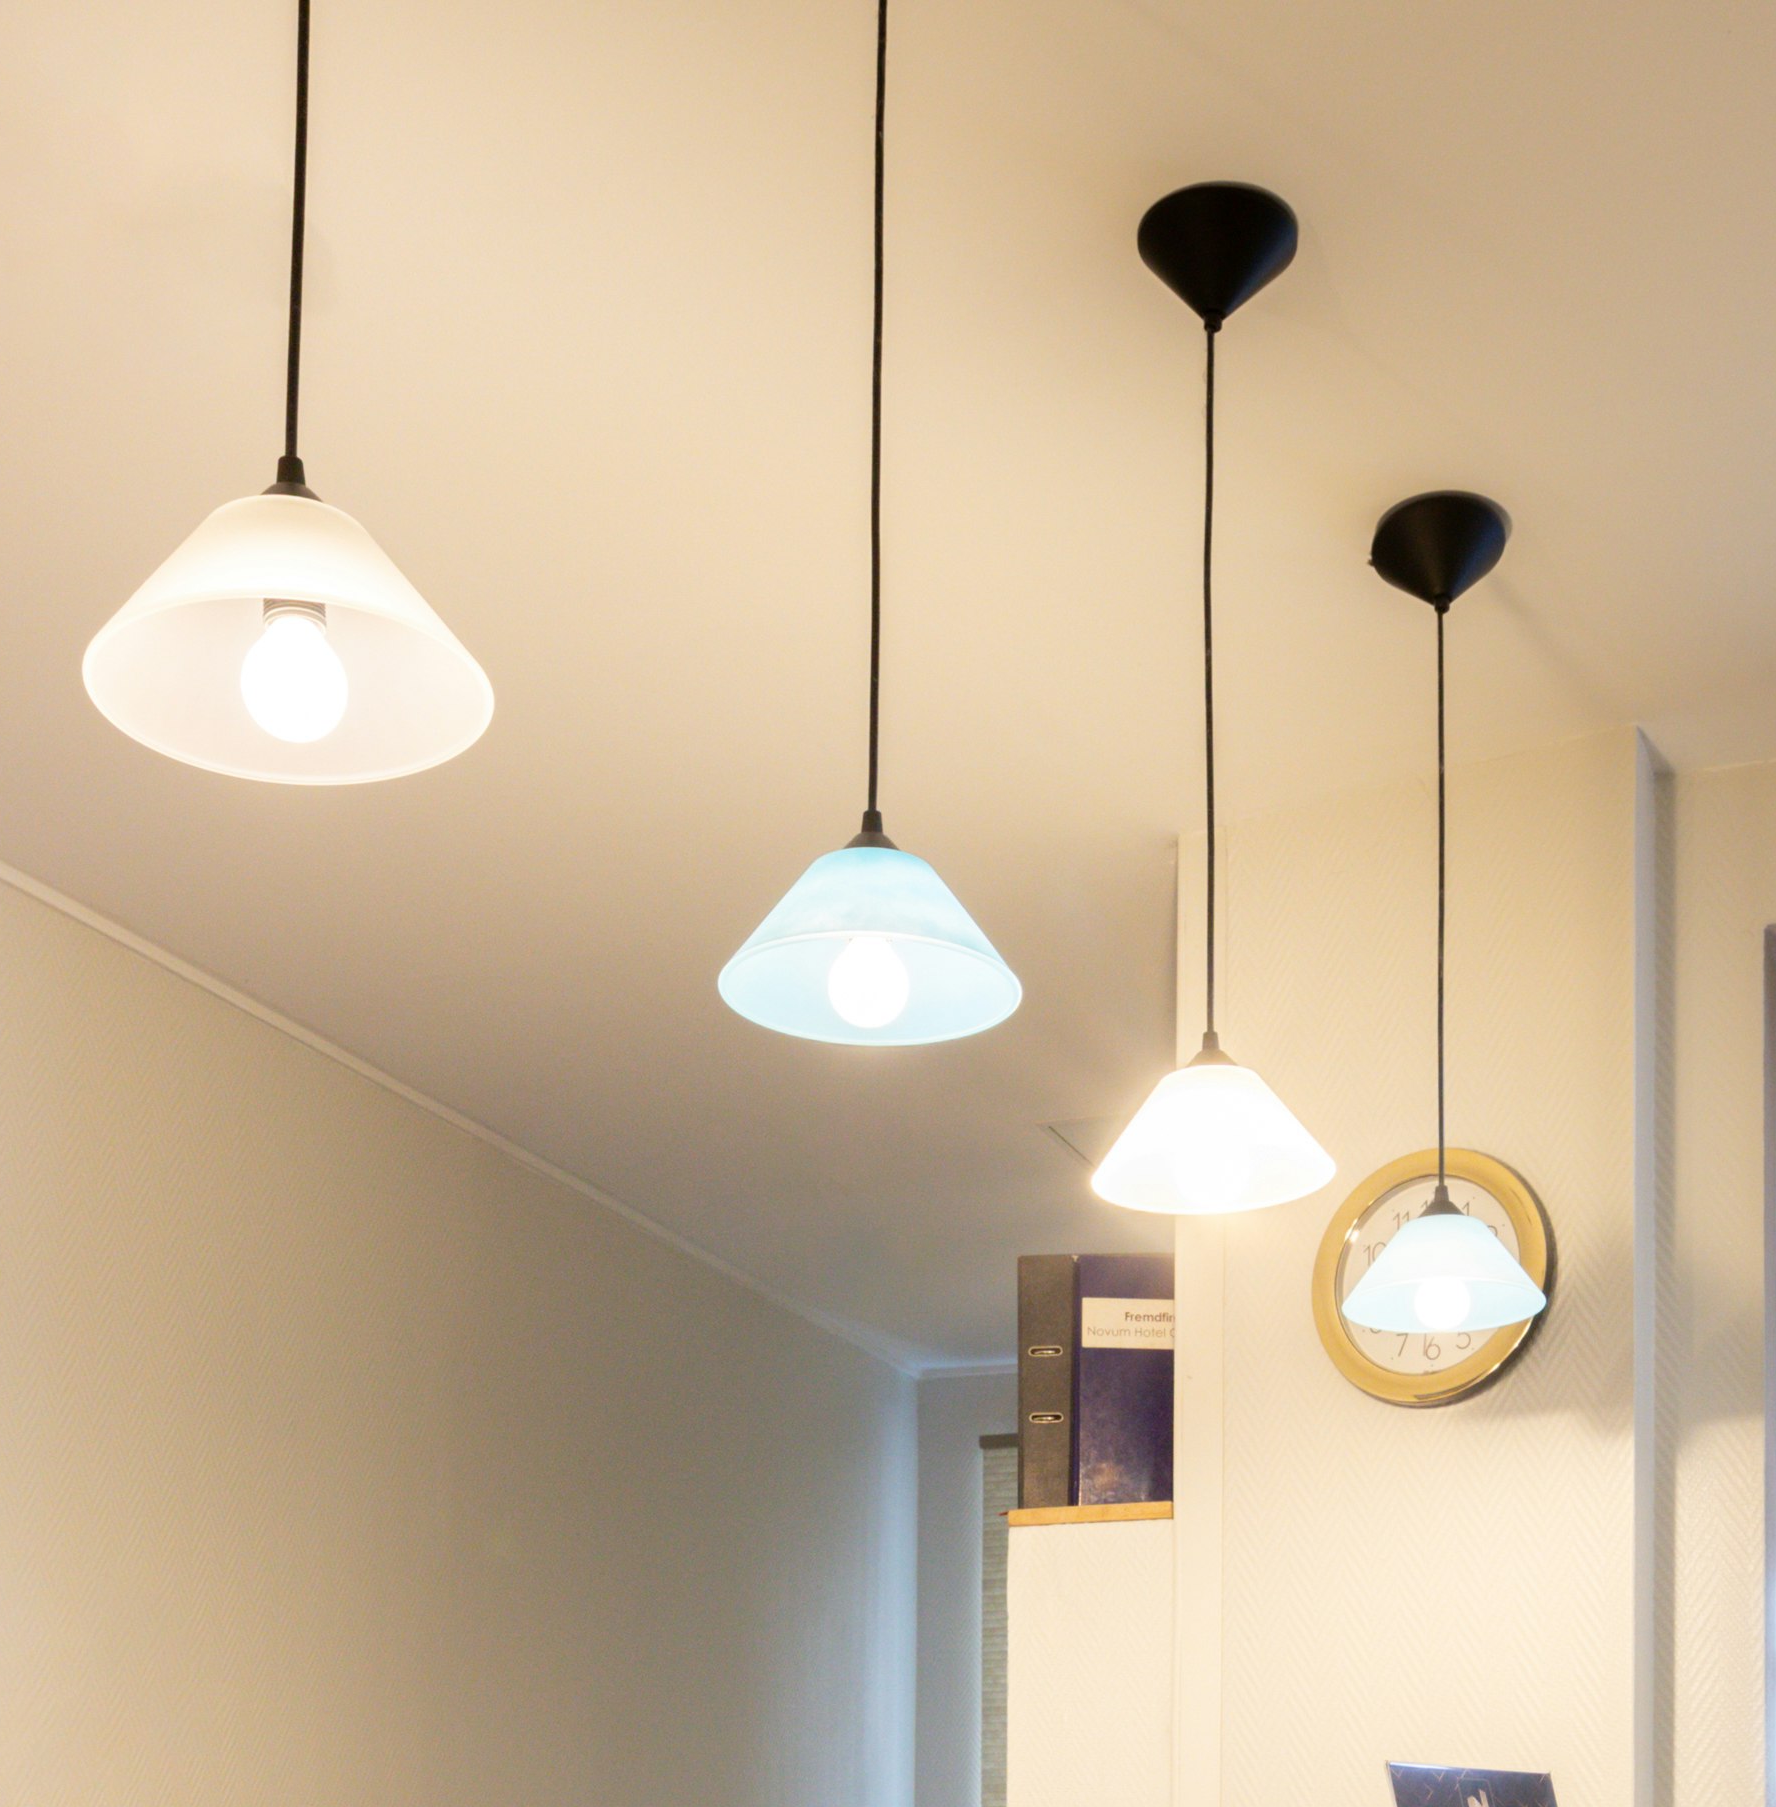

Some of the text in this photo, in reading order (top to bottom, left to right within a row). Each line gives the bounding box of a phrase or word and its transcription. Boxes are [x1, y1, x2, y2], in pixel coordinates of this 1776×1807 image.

[1087, 1326, 1131, 1337] Novum
[1134, 1327, 1166, 1338] Hotel
[1396, 1333, 1409, 1357] 7
[1425, 1337, 1441, 1361] 6
